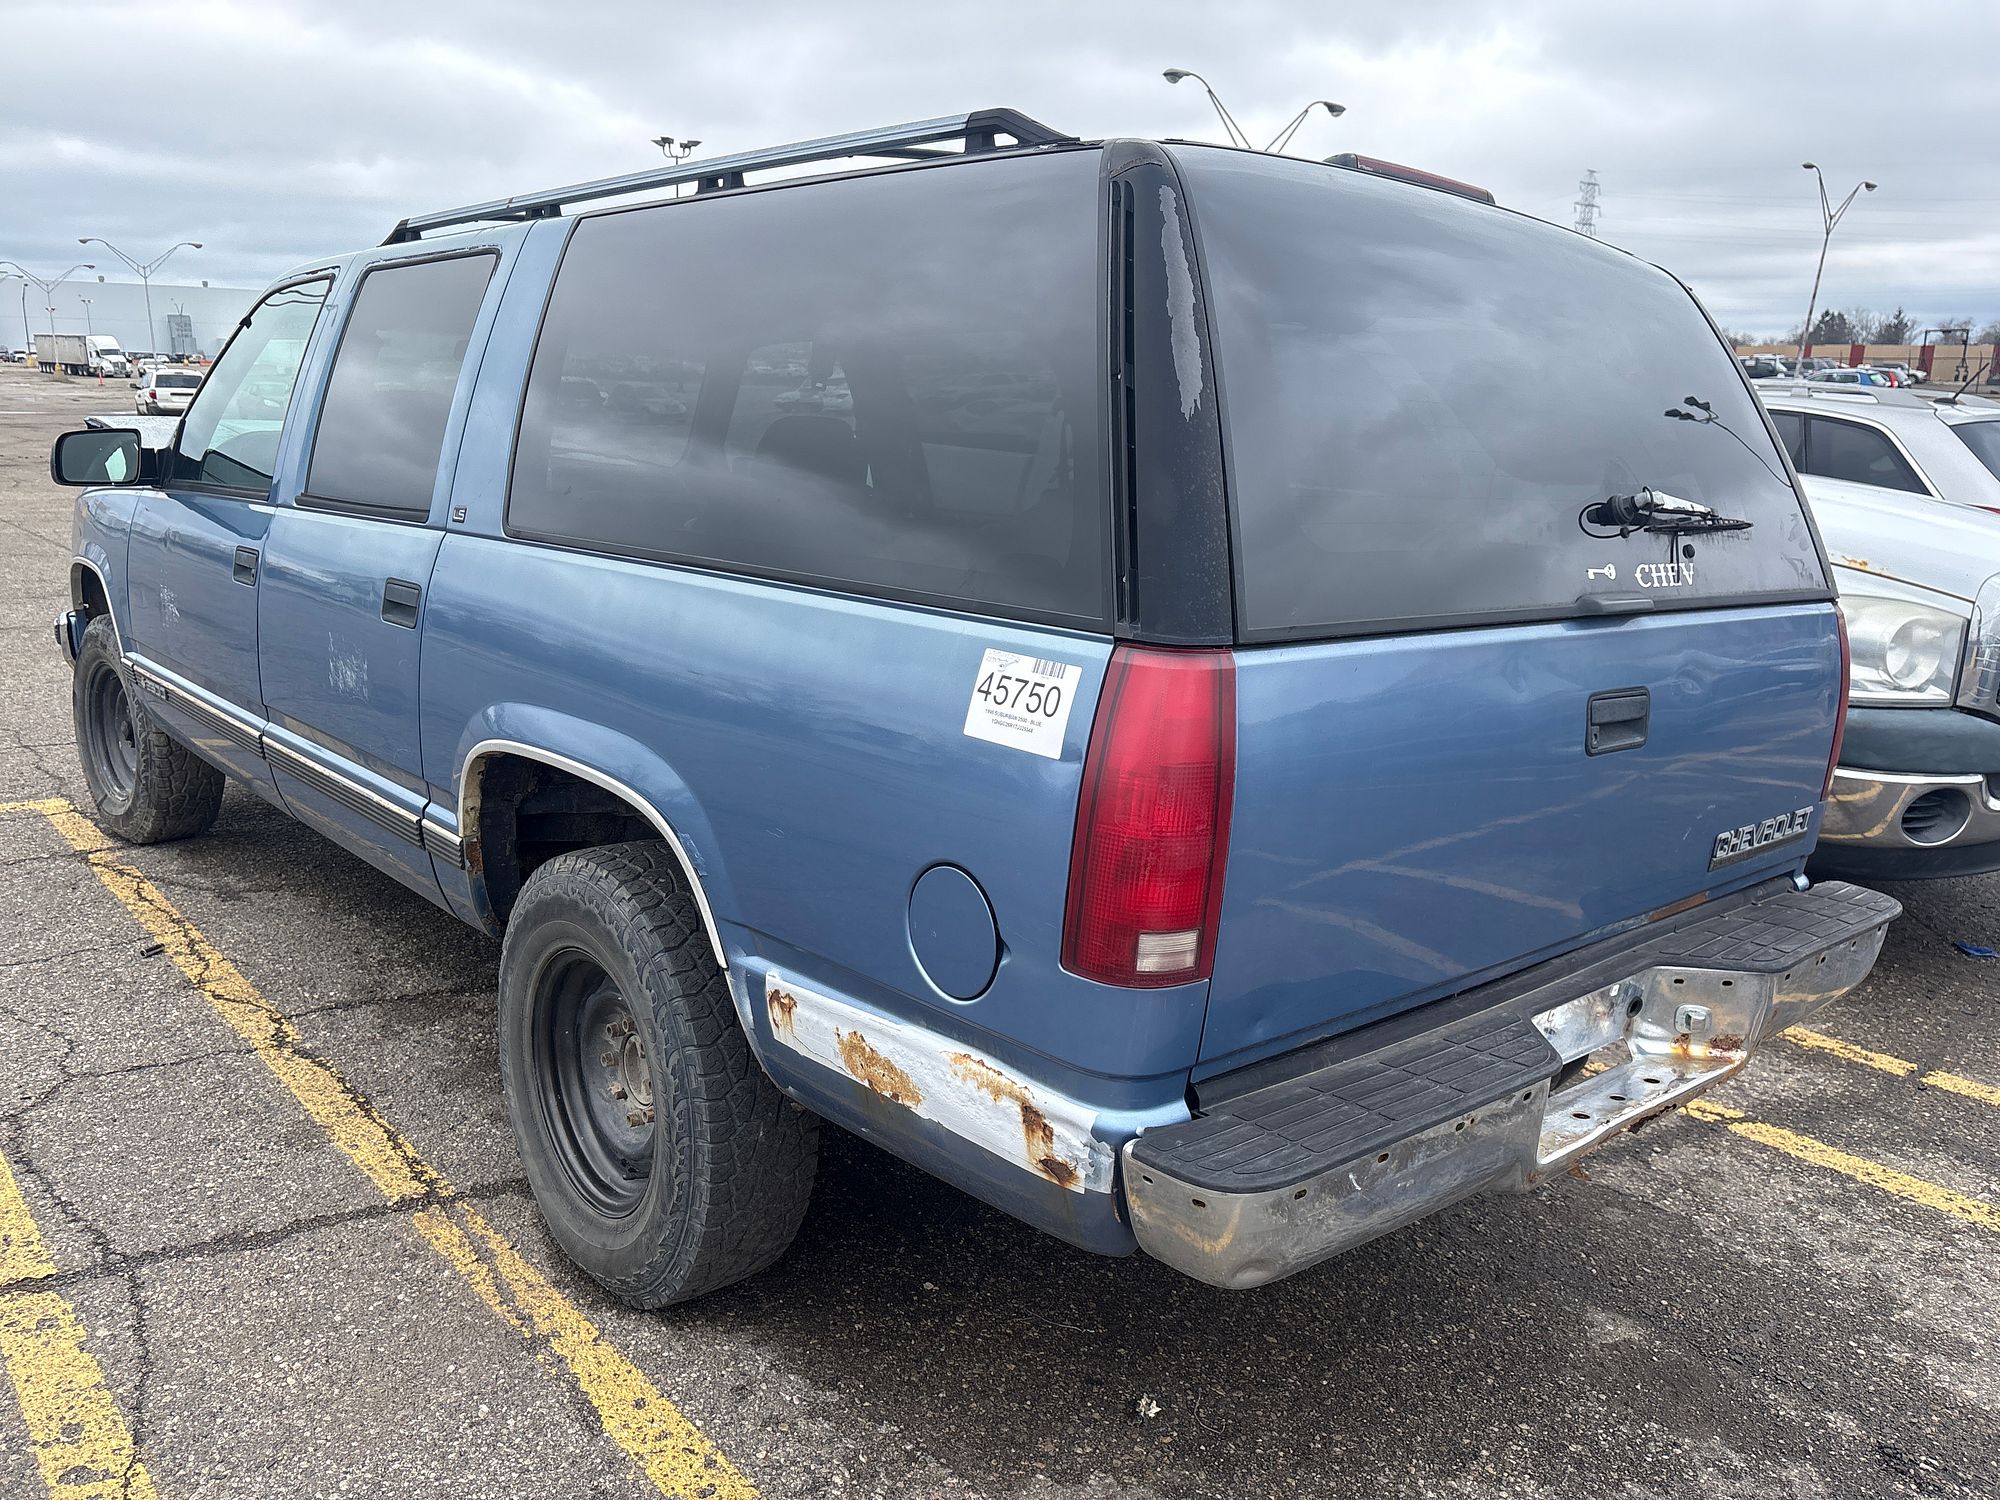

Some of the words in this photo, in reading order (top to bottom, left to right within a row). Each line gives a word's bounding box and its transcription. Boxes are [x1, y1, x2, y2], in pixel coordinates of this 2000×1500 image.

[453, 508, 466, 521] LS
[1635, 562, 1694, 588] CHEV
[977, 671, 1061, 718] 45750
[1713, 805, 1814, 858] CHEVROLET
